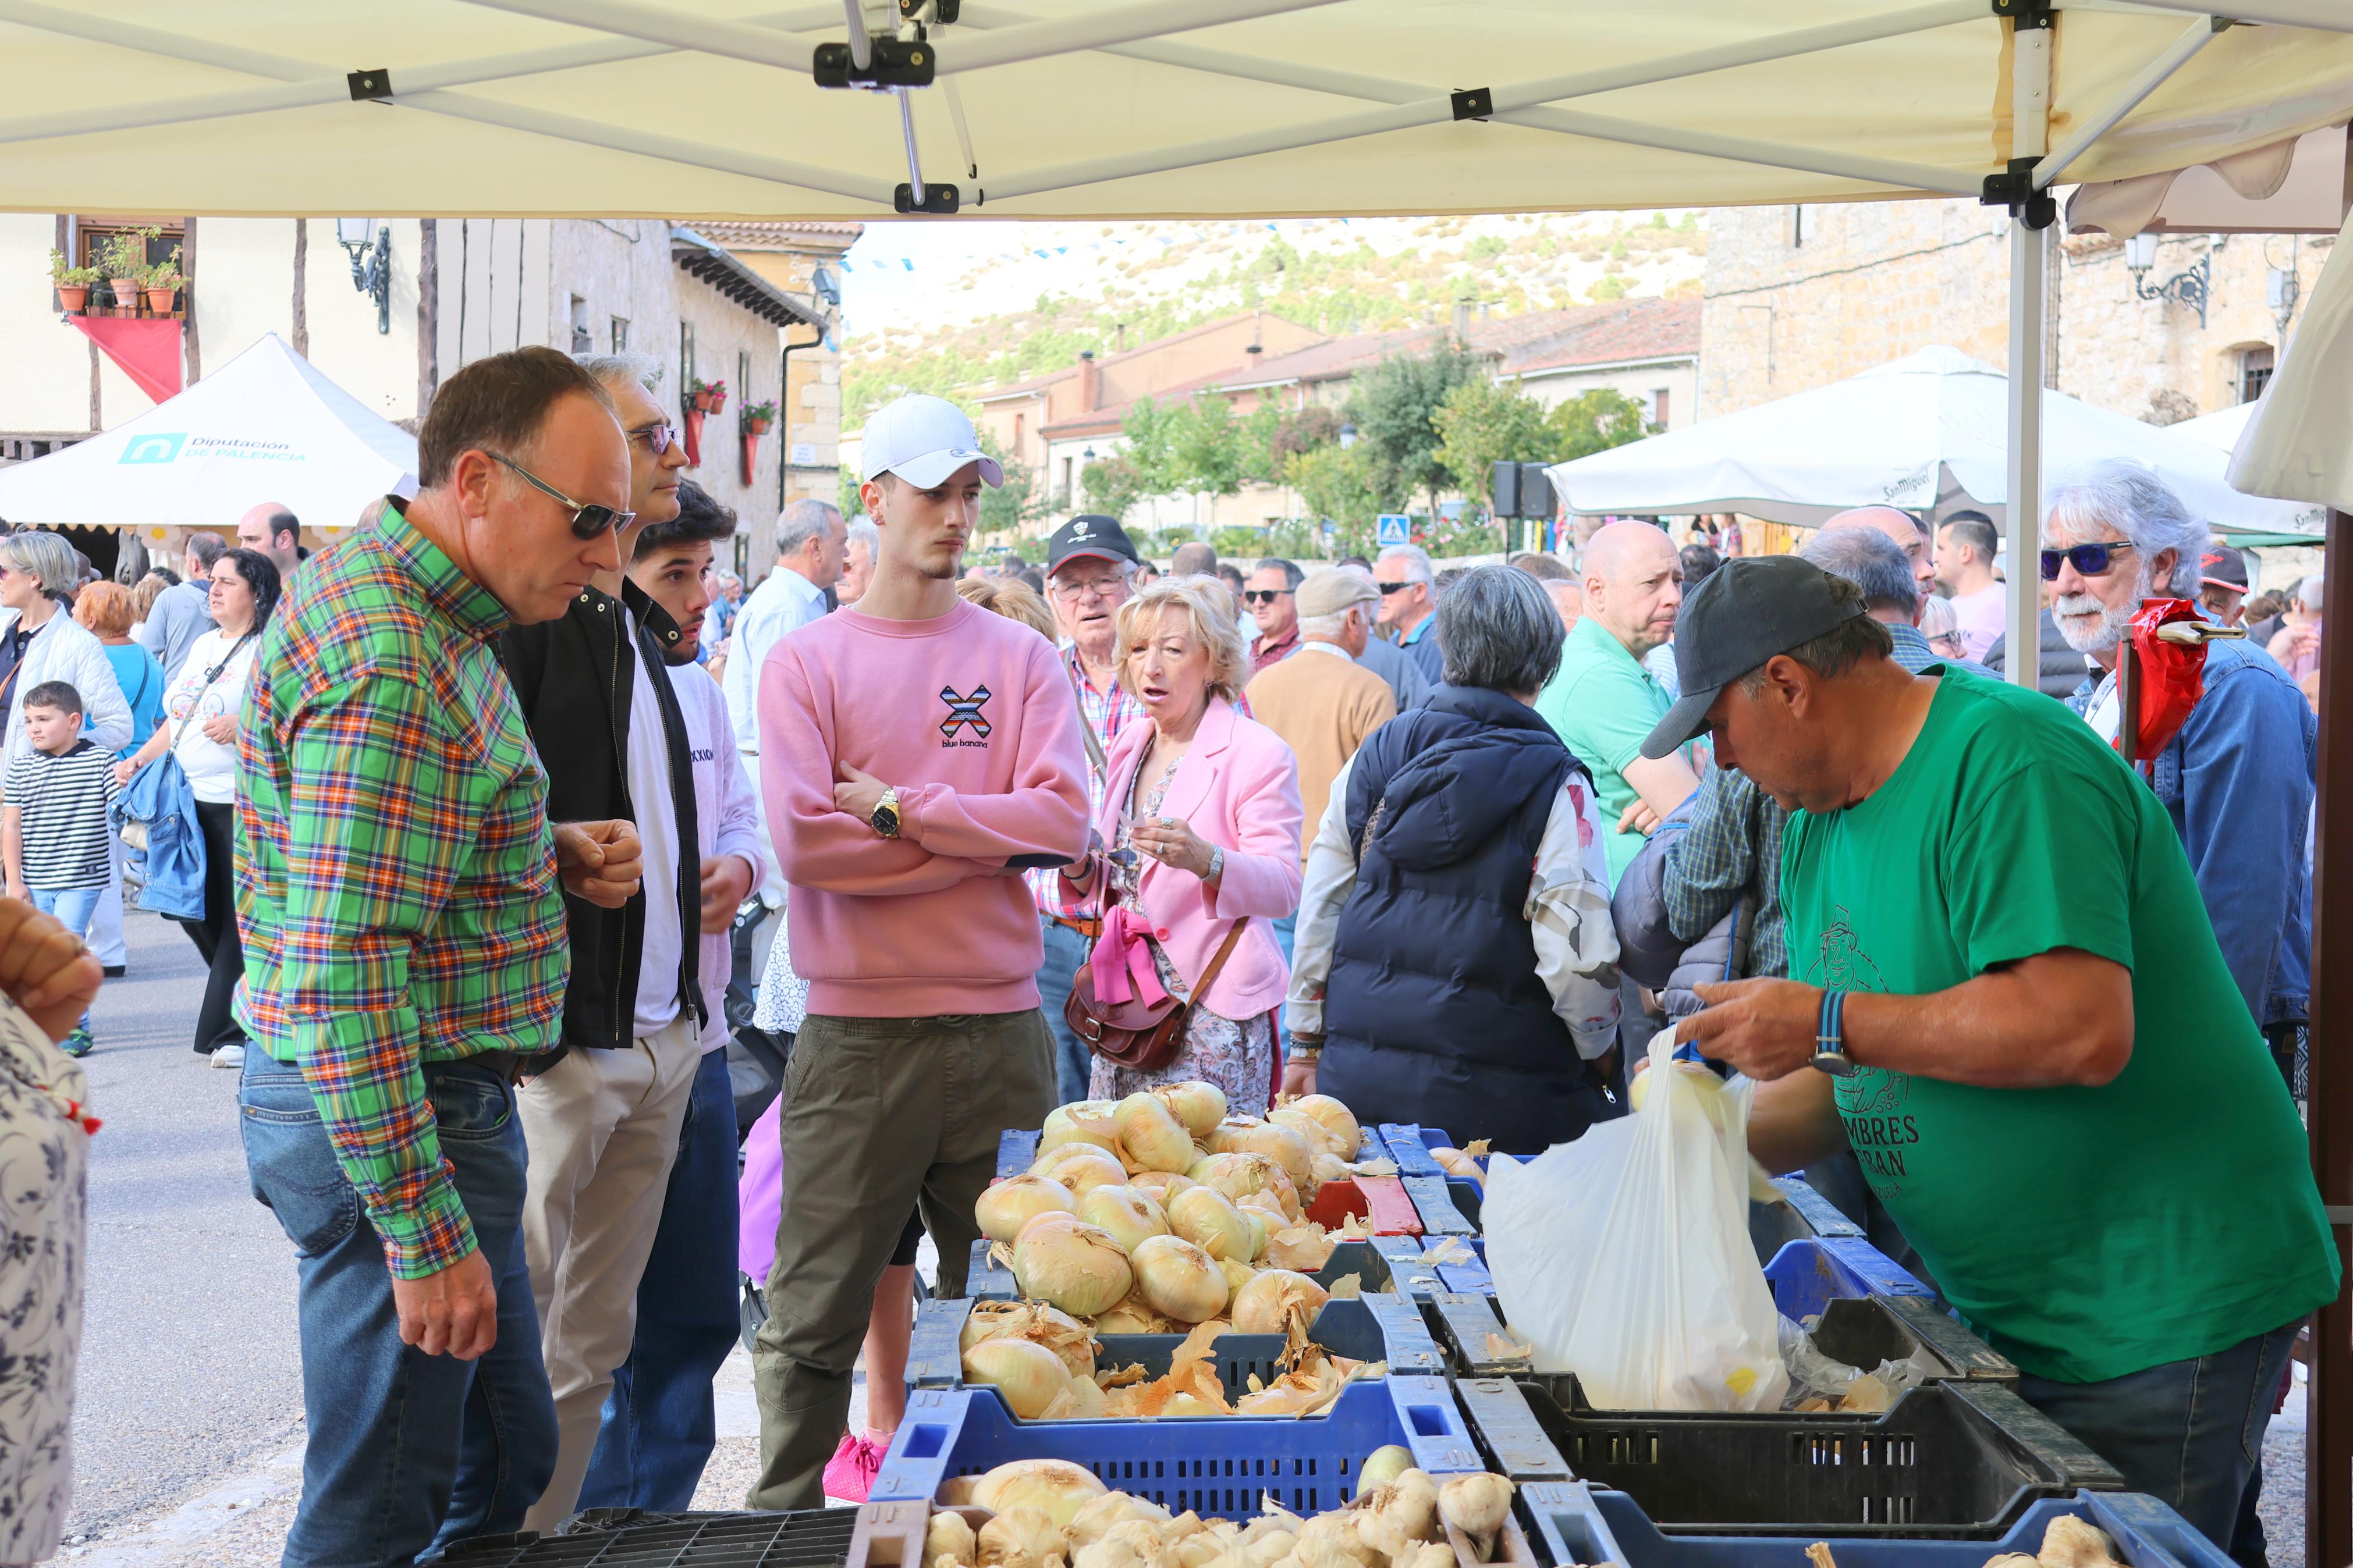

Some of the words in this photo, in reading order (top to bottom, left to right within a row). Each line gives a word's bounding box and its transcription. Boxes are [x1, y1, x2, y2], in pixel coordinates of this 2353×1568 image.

[191, 438, 289, 450] Diputación
[185, 449, 210, 457] DE
[215, 449, 307, 461] PALENCIA
[942, 739, 958, 748] blue
[959, 739, 988, 748] banana
